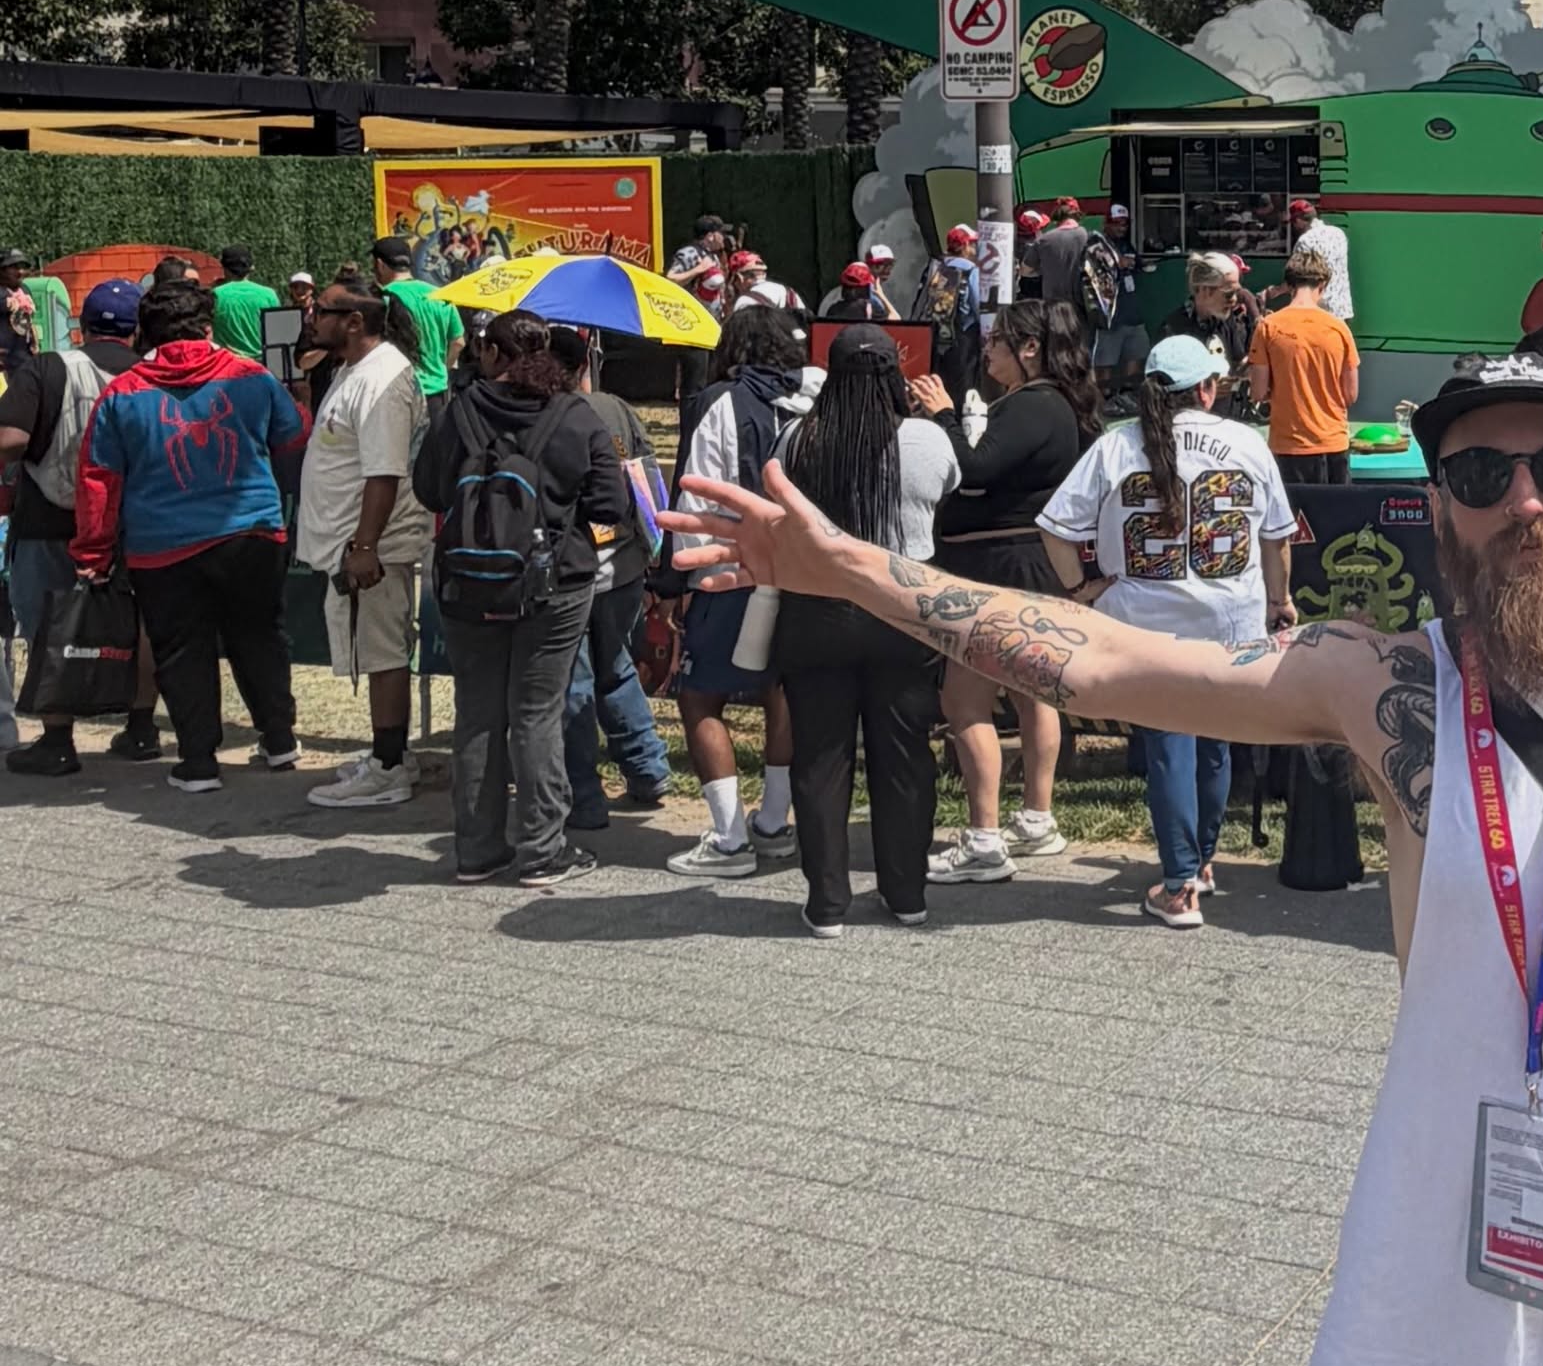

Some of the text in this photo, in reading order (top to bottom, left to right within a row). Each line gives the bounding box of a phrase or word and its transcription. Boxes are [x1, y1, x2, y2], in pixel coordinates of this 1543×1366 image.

[1025, 13, 1077, 47] PLANET
[946, 51, 1013, 65] NO CAMPING
[1042, 61, 1100, 102] ESPRESSO
[1183, 431, 1232, 461] DIEGO
[1121, 469, 1254, 580] 26
[1477, 765, 1496, 796] STAR
[1482, 796, 1504, 829] TREK
